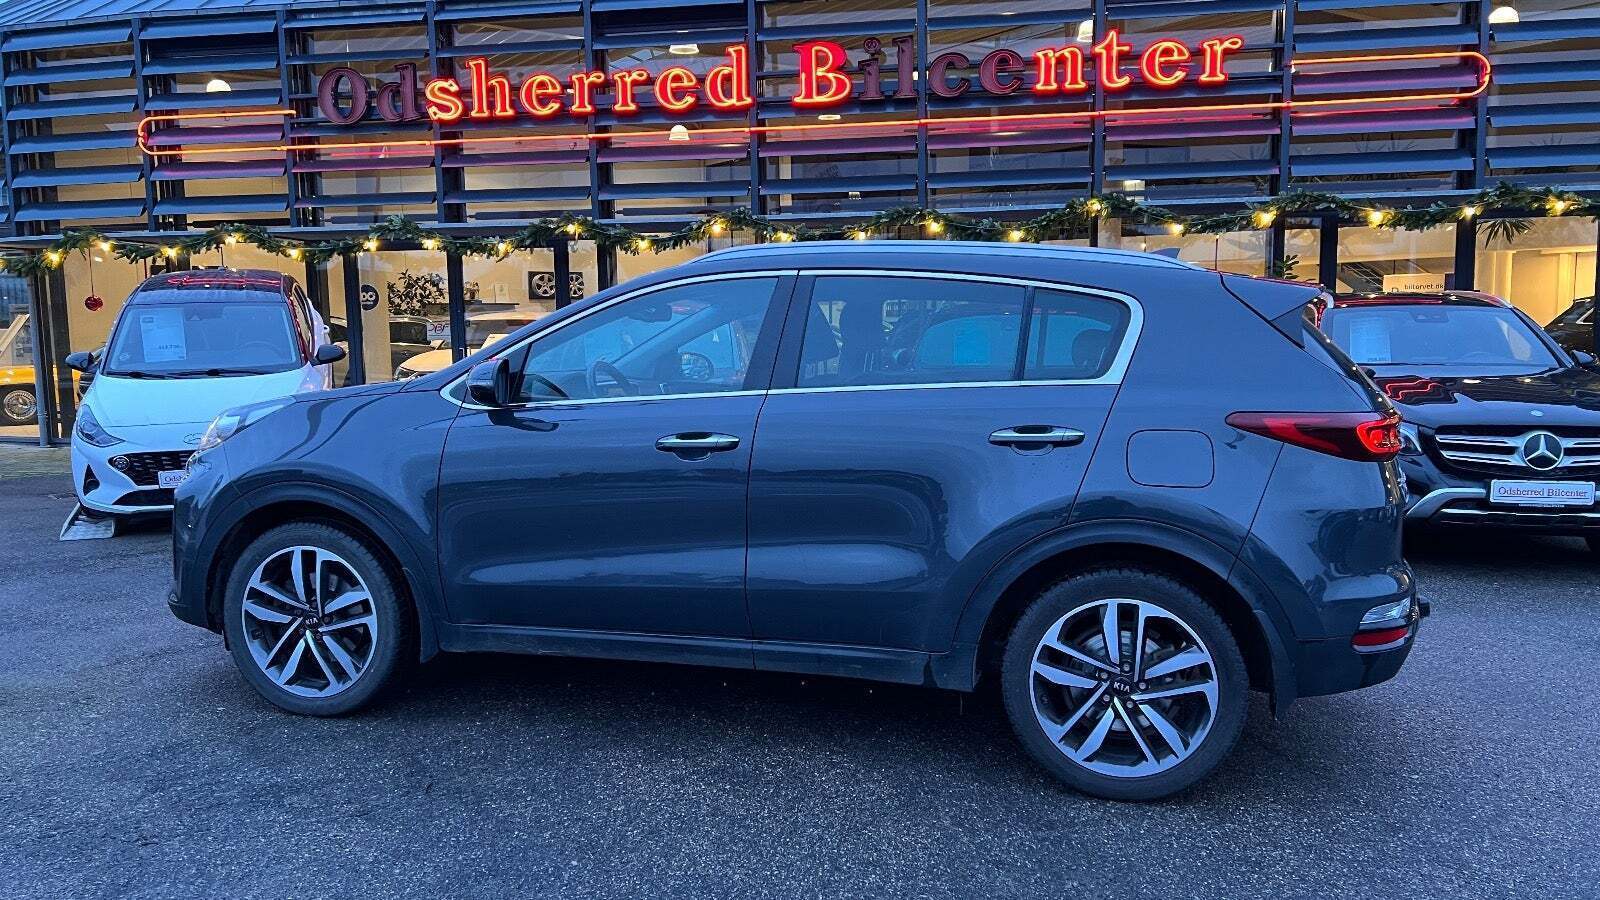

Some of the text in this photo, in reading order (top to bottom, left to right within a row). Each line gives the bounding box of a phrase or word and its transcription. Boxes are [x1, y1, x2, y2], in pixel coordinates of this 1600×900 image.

[317, 28, 1245, 125] Odsherred Bilcenter
[1498, 486, 1588, 498] Odsherred Bilcenter
[1113, 681, 1131, 693] KIA
